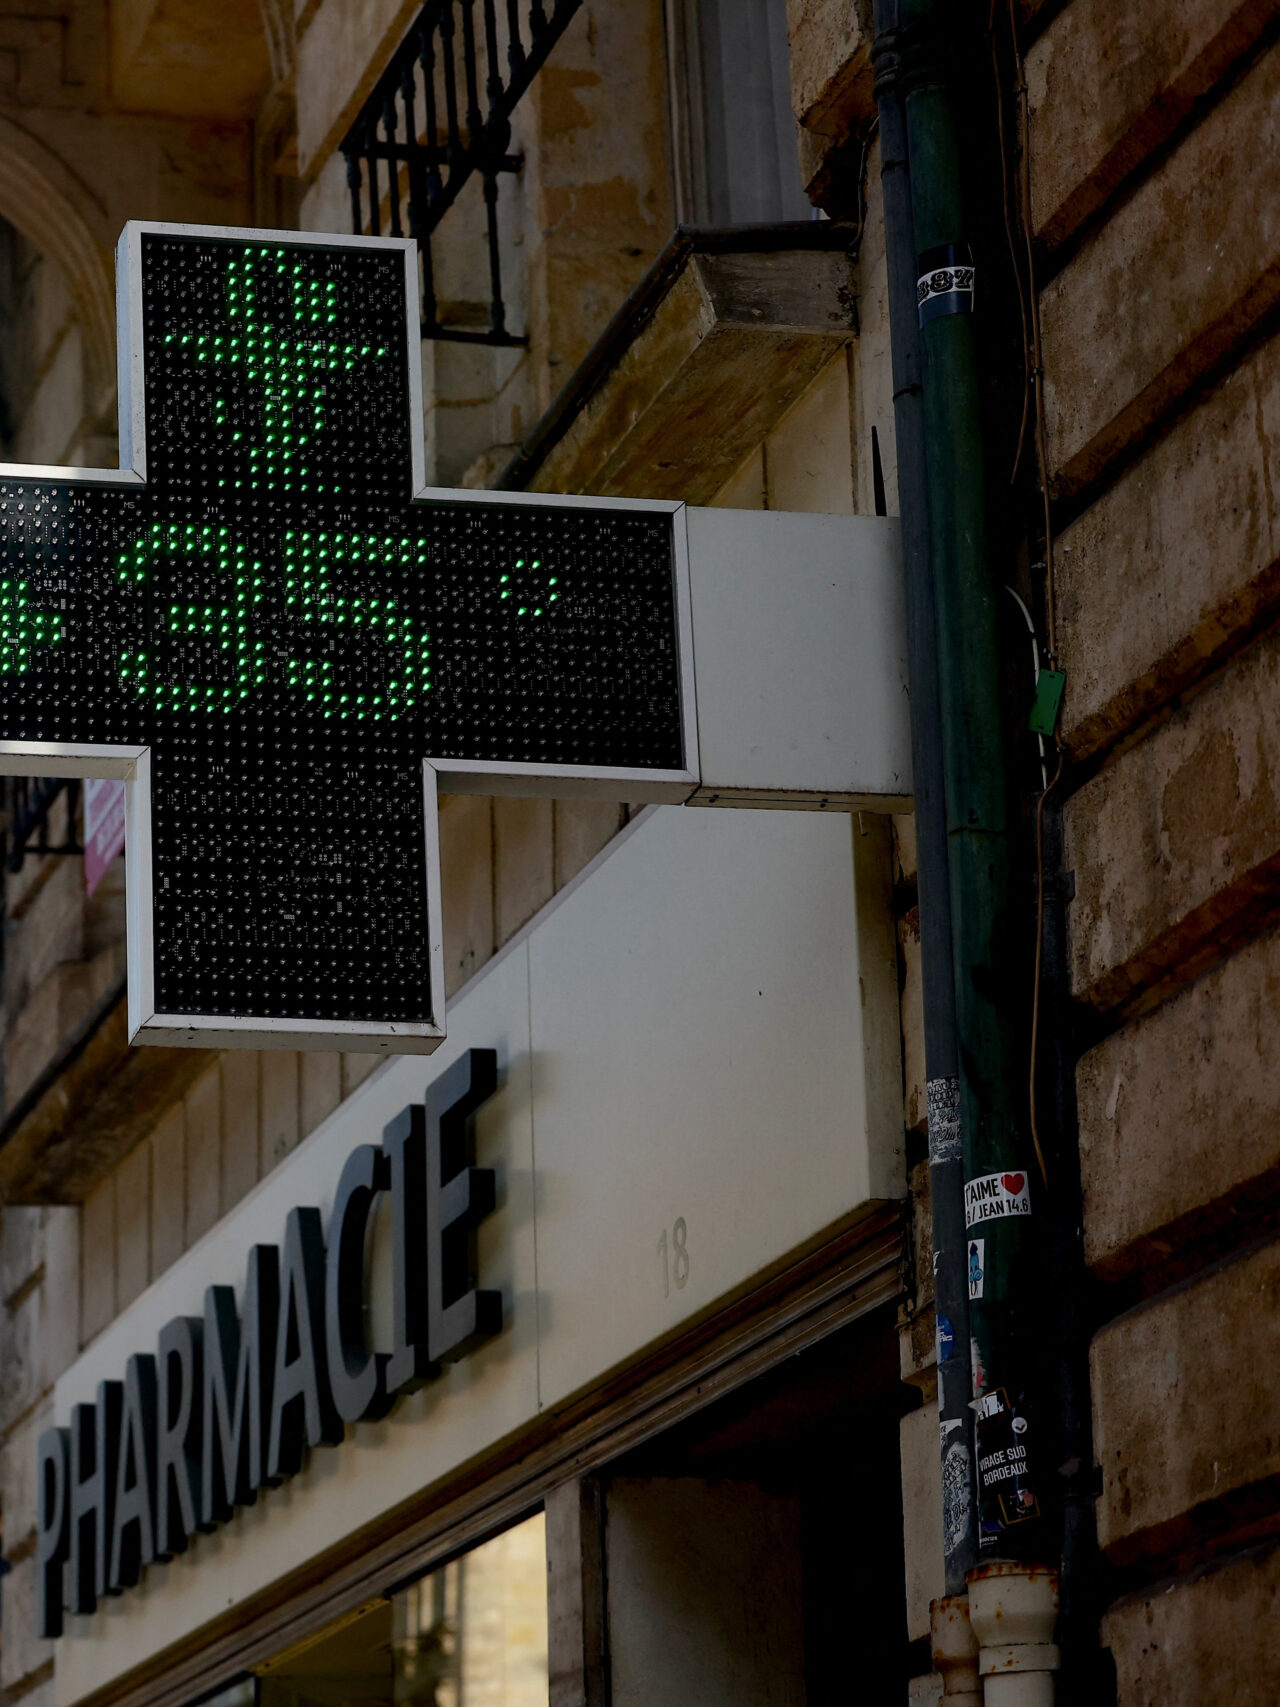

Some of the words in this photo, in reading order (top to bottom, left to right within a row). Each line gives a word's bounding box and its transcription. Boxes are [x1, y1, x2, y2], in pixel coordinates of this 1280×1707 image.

[388, 515, 400, 523] MS
[396, 772, 408, 780] MS
[978, 1200, 1004, 1219] JEAN
[1005, 1197, 1029, 1213] 14.6
[656, 1216, 689, 1299] 18
[36, 1048, 503, 1639] PHARMACIE
[978, 1450, 1006, 1472] VIRAGE
[1007, 1445, 1027, 1461] SUD
[983, 1461, 1028, 1486] BORDEAUX
